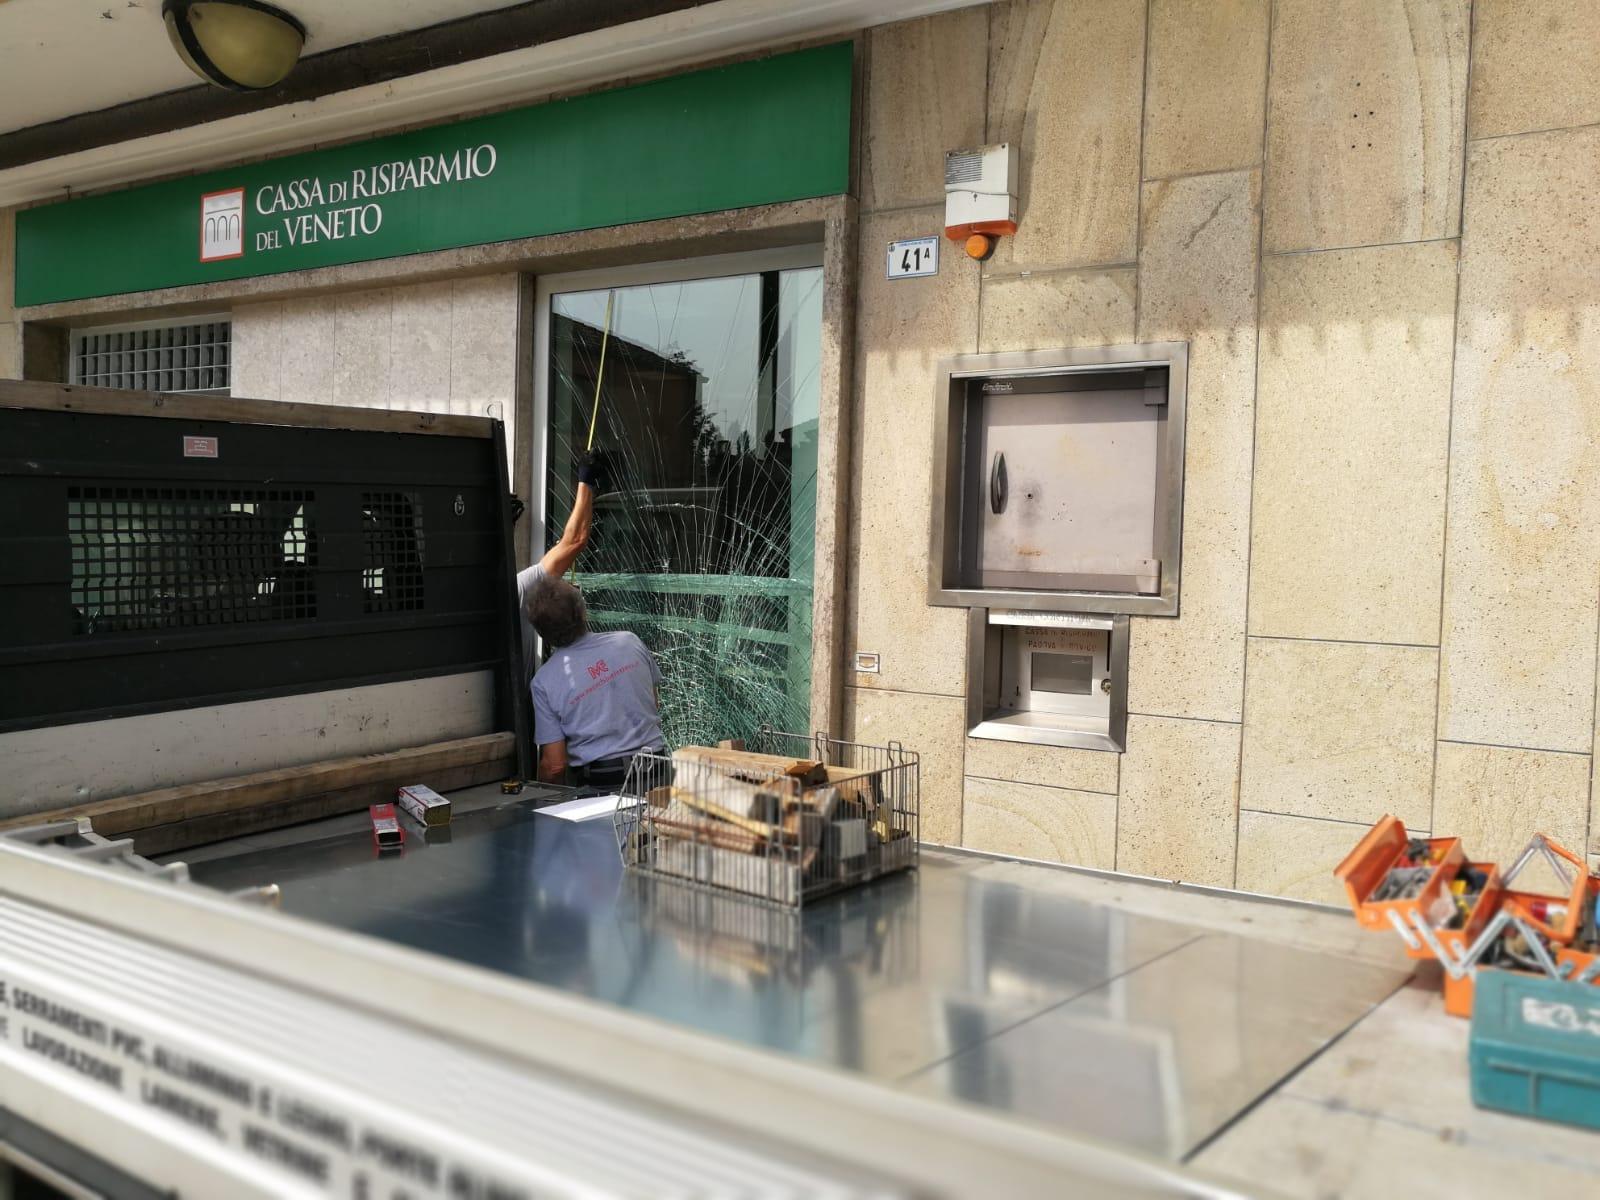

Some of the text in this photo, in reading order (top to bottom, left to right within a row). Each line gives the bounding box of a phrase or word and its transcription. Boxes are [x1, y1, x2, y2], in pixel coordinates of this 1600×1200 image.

[255, 144, 497, 215] CASSA DI RISPARMIO
[256, 203, 383, 251] DEL VENETO
[13, 988, 108, 1046] SERRAMENTI
[22, 1026, 123, 1093] LAVORAZIONE
